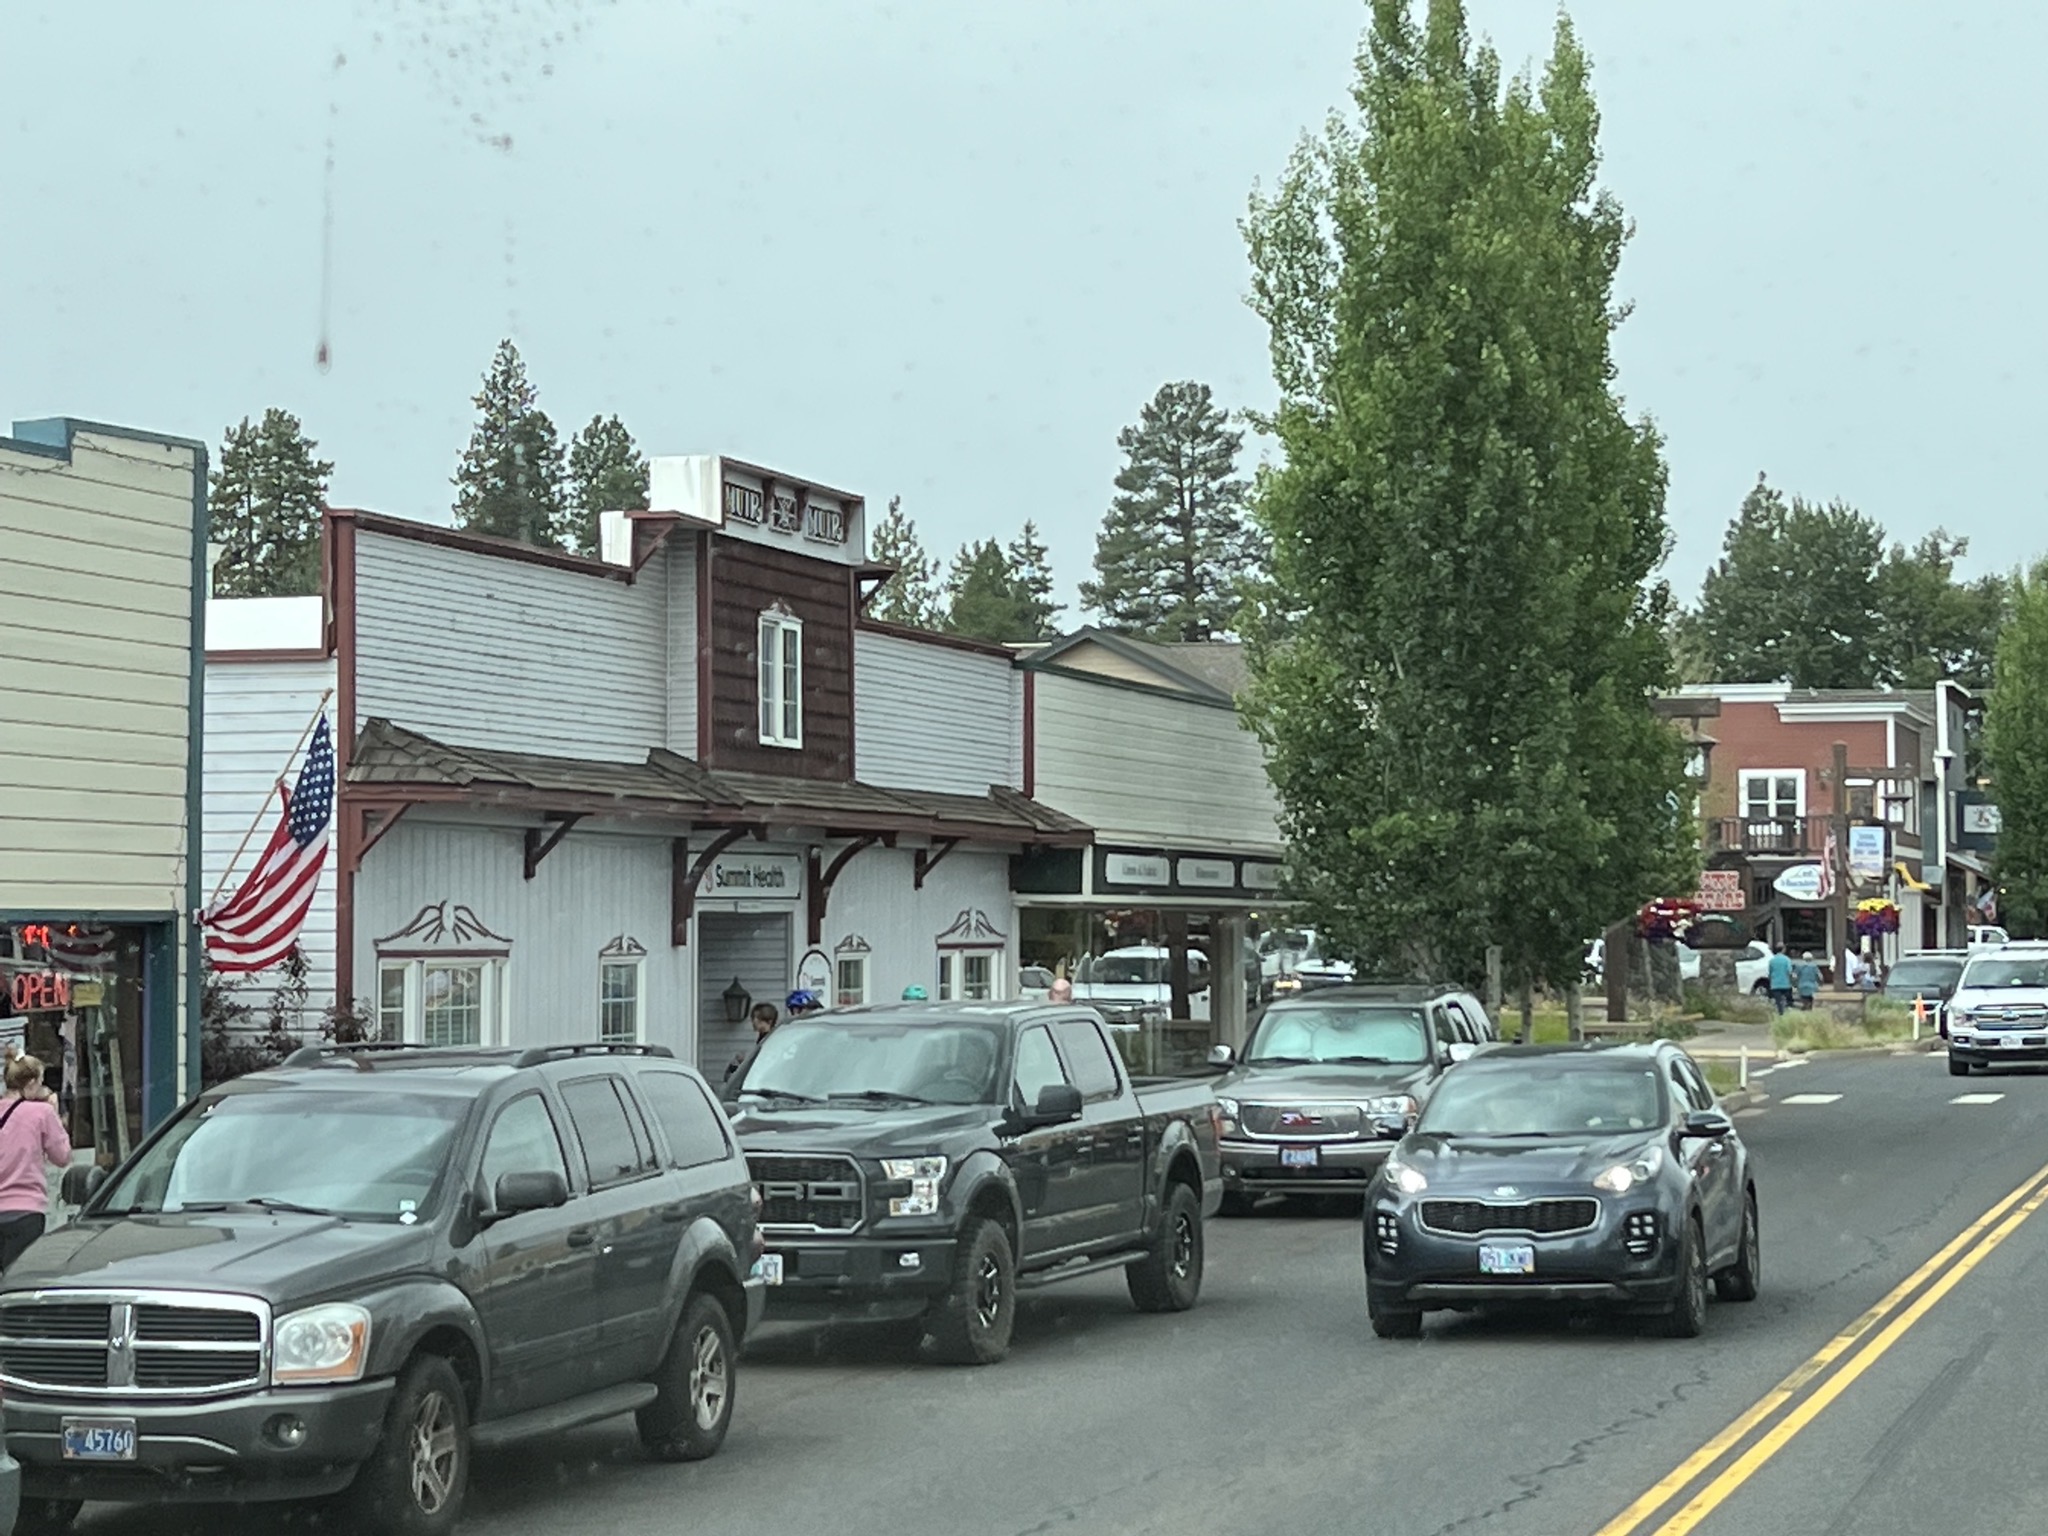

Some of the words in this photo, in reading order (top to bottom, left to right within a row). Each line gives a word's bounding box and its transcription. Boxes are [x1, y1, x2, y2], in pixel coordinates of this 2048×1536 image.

[715, 864, 751, 888] Summit
[753, 864, 785, 887] Health
[13, 973, 68, 1008] OPEN
[85, 1428, 134, 1453] 45760
